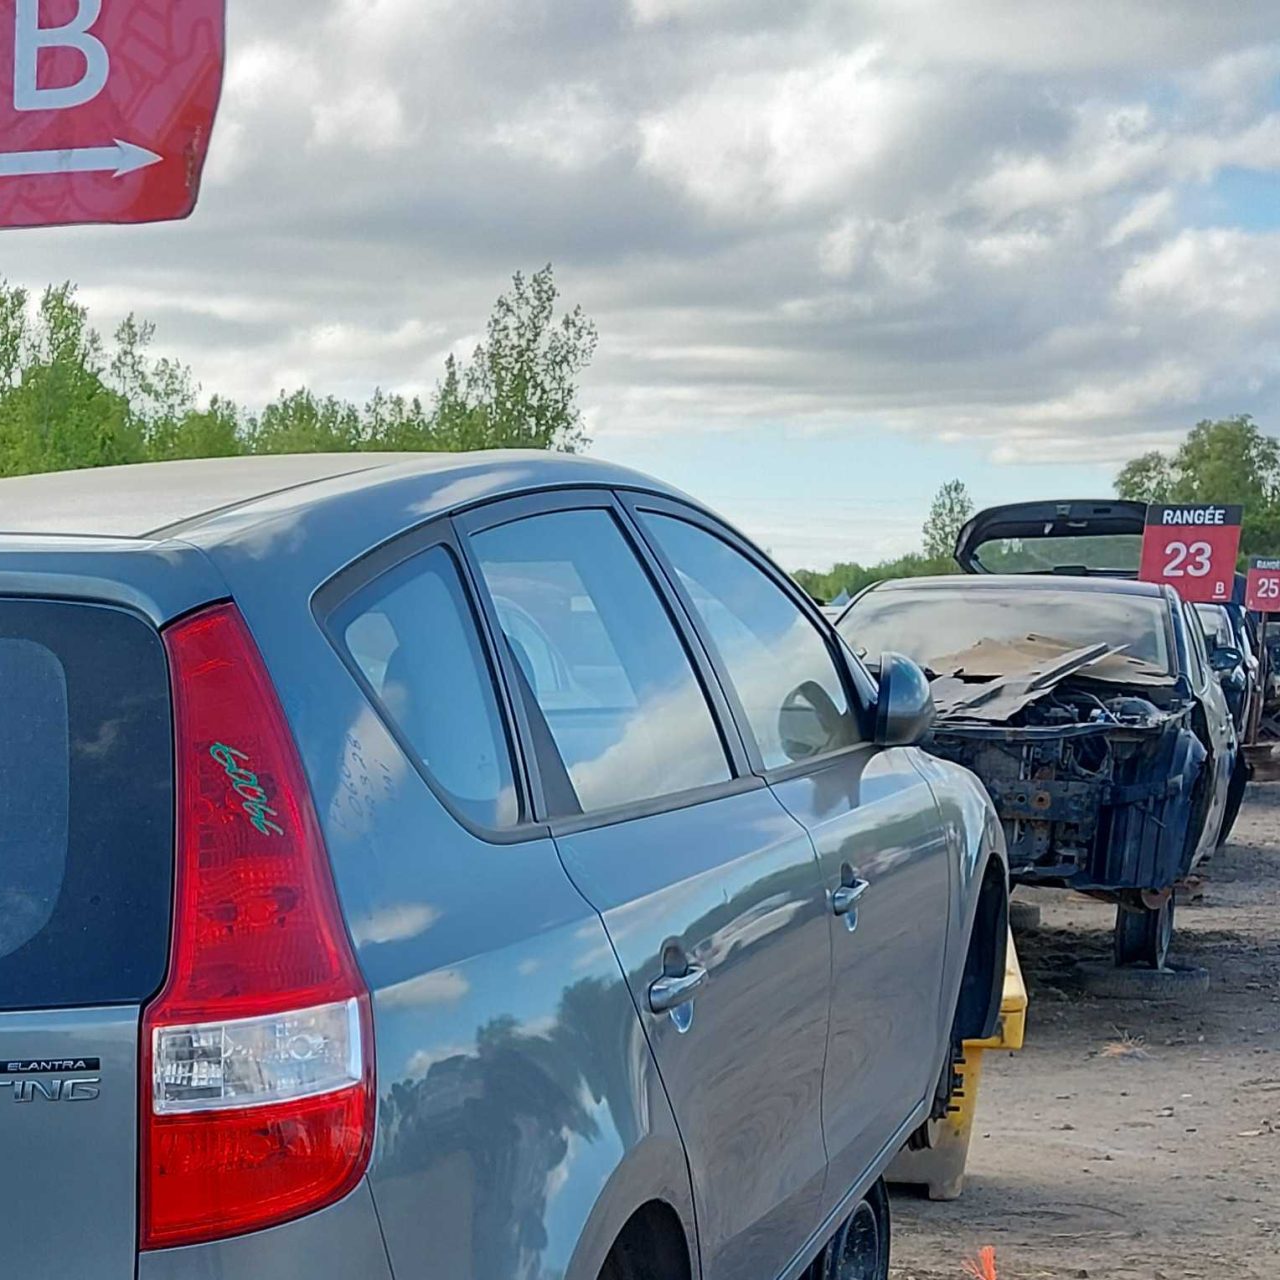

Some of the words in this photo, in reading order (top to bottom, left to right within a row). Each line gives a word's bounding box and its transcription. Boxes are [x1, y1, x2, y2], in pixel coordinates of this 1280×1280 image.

[14, 0, 110, 111] B
[1162, 506, 1226, 524] RANGÉE
[1163, 541, 1212, 577] 23
[1215, 582, 1224, 594] B
[1257, 578, 1280, 598] 25
[7, 1060, 86, 1072] ELANTRA
